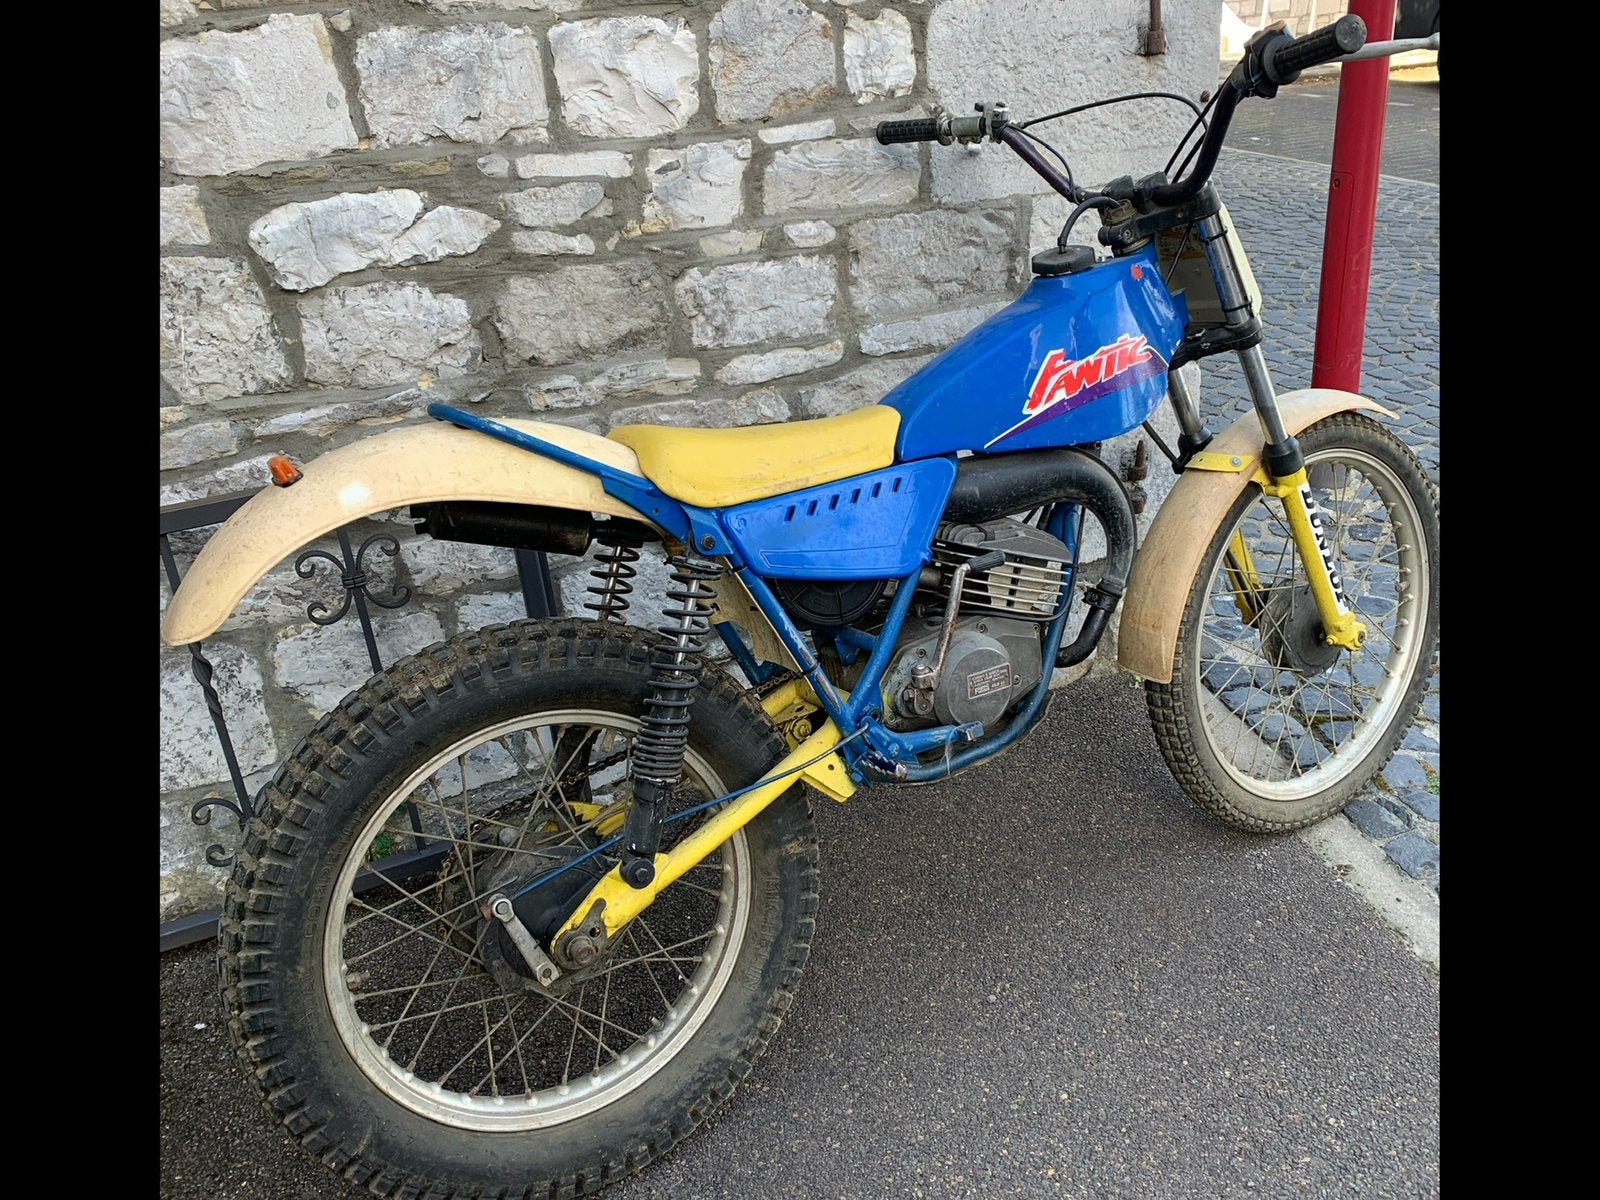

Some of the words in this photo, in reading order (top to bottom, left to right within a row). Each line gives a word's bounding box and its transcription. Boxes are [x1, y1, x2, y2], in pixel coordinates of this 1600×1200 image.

[1023, 334, 1152, 413] FANTIC
[1301, 489, 1350, 609] DUNLOP
[742, 877, 780, 991] MICHELIN
